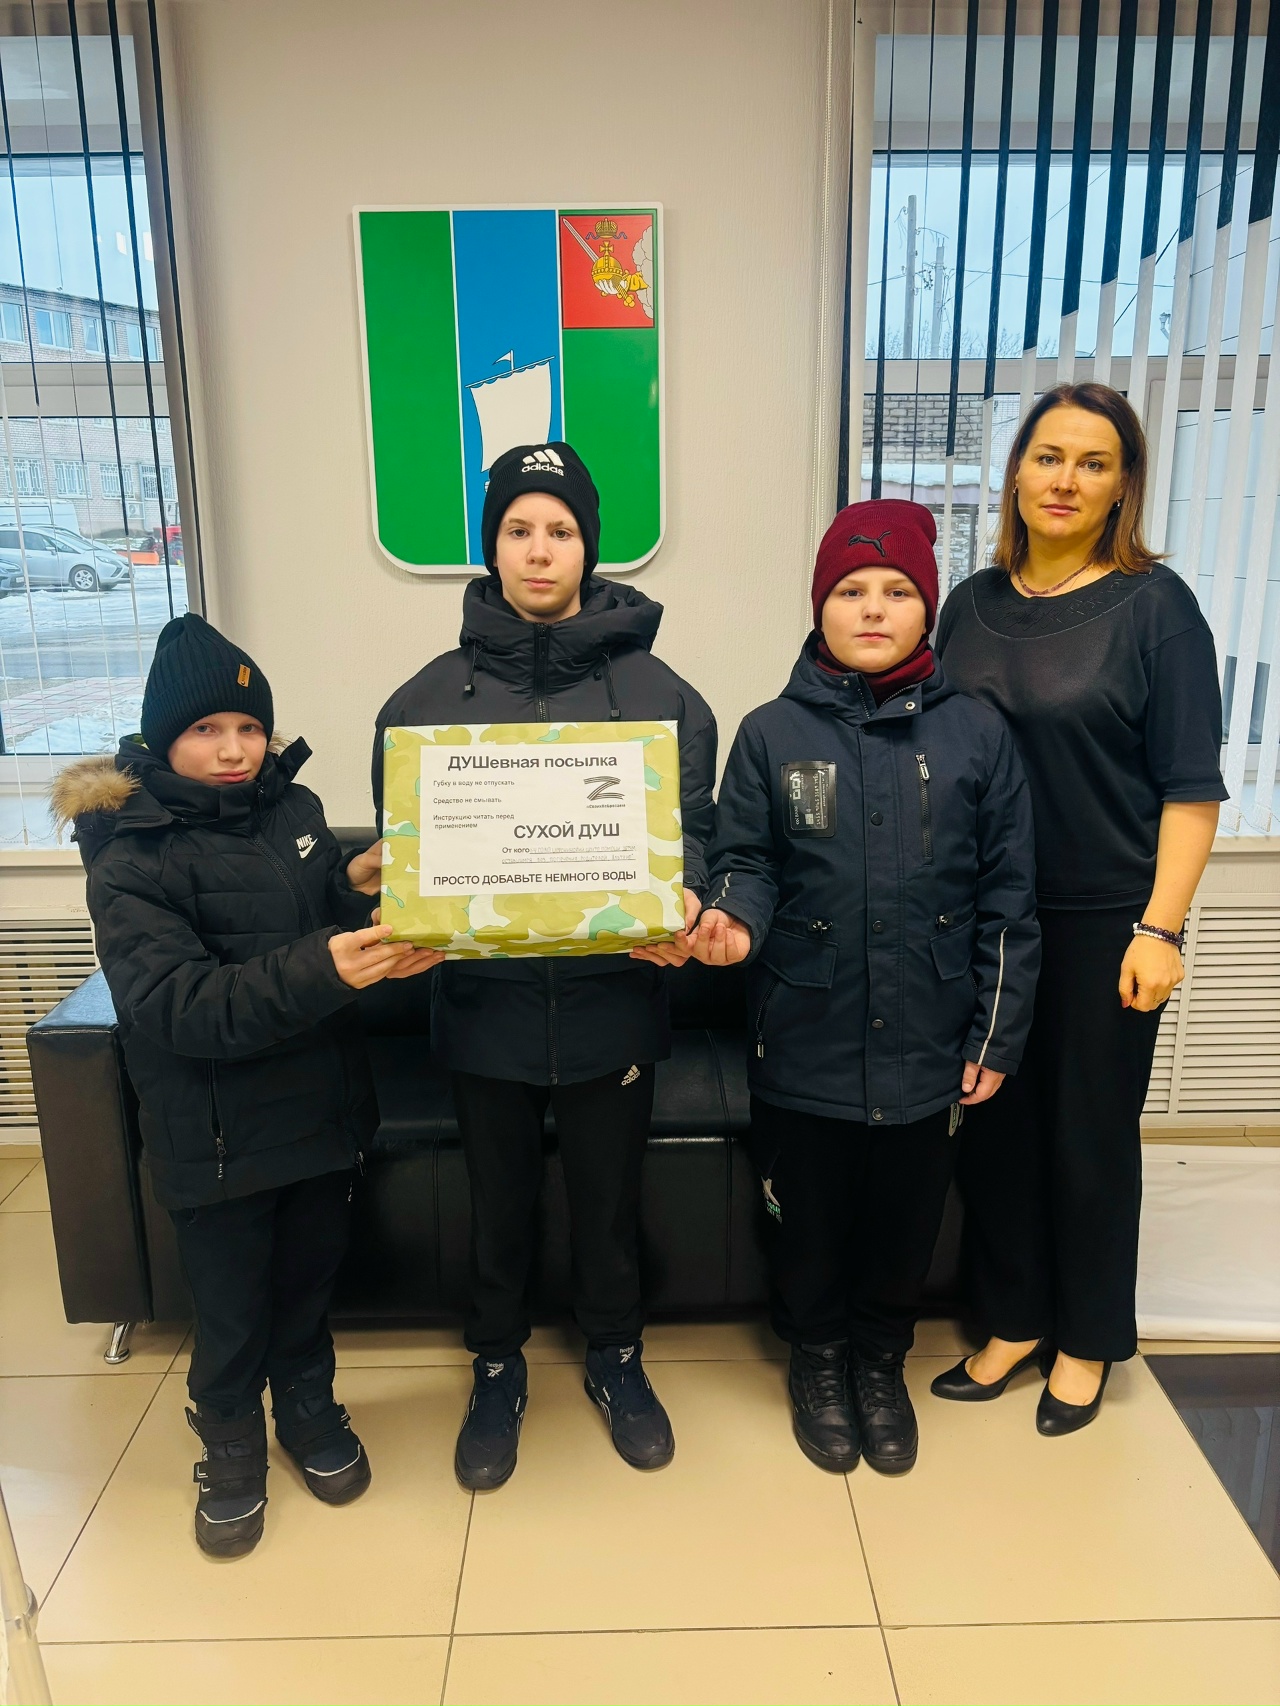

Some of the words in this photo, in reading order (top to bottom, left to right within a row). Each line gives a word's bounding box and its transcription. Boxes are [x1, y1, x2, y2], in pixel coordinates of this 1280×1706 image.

[521, 463, 565, 476] adidas
[448, 756, 540, 771] ДУШевная
[544, 756, 618, 768] посылка
[433, 780, 451, 788] Губку
[433, 797, 464, 805] Средство
[513, 820, 575, 839] СУХОЙ
[578, 822, 620, 840] ДУШ
[296, 834, 313, 849] NIKE
[433, 874, 480, 886] ПРОСТО
[482, 873, 543, 886] ДОБАВЬТЕ
[545, 872, 600, 882] НЕМНОГО
[602, 870, 637, 881] ВОДЫ
